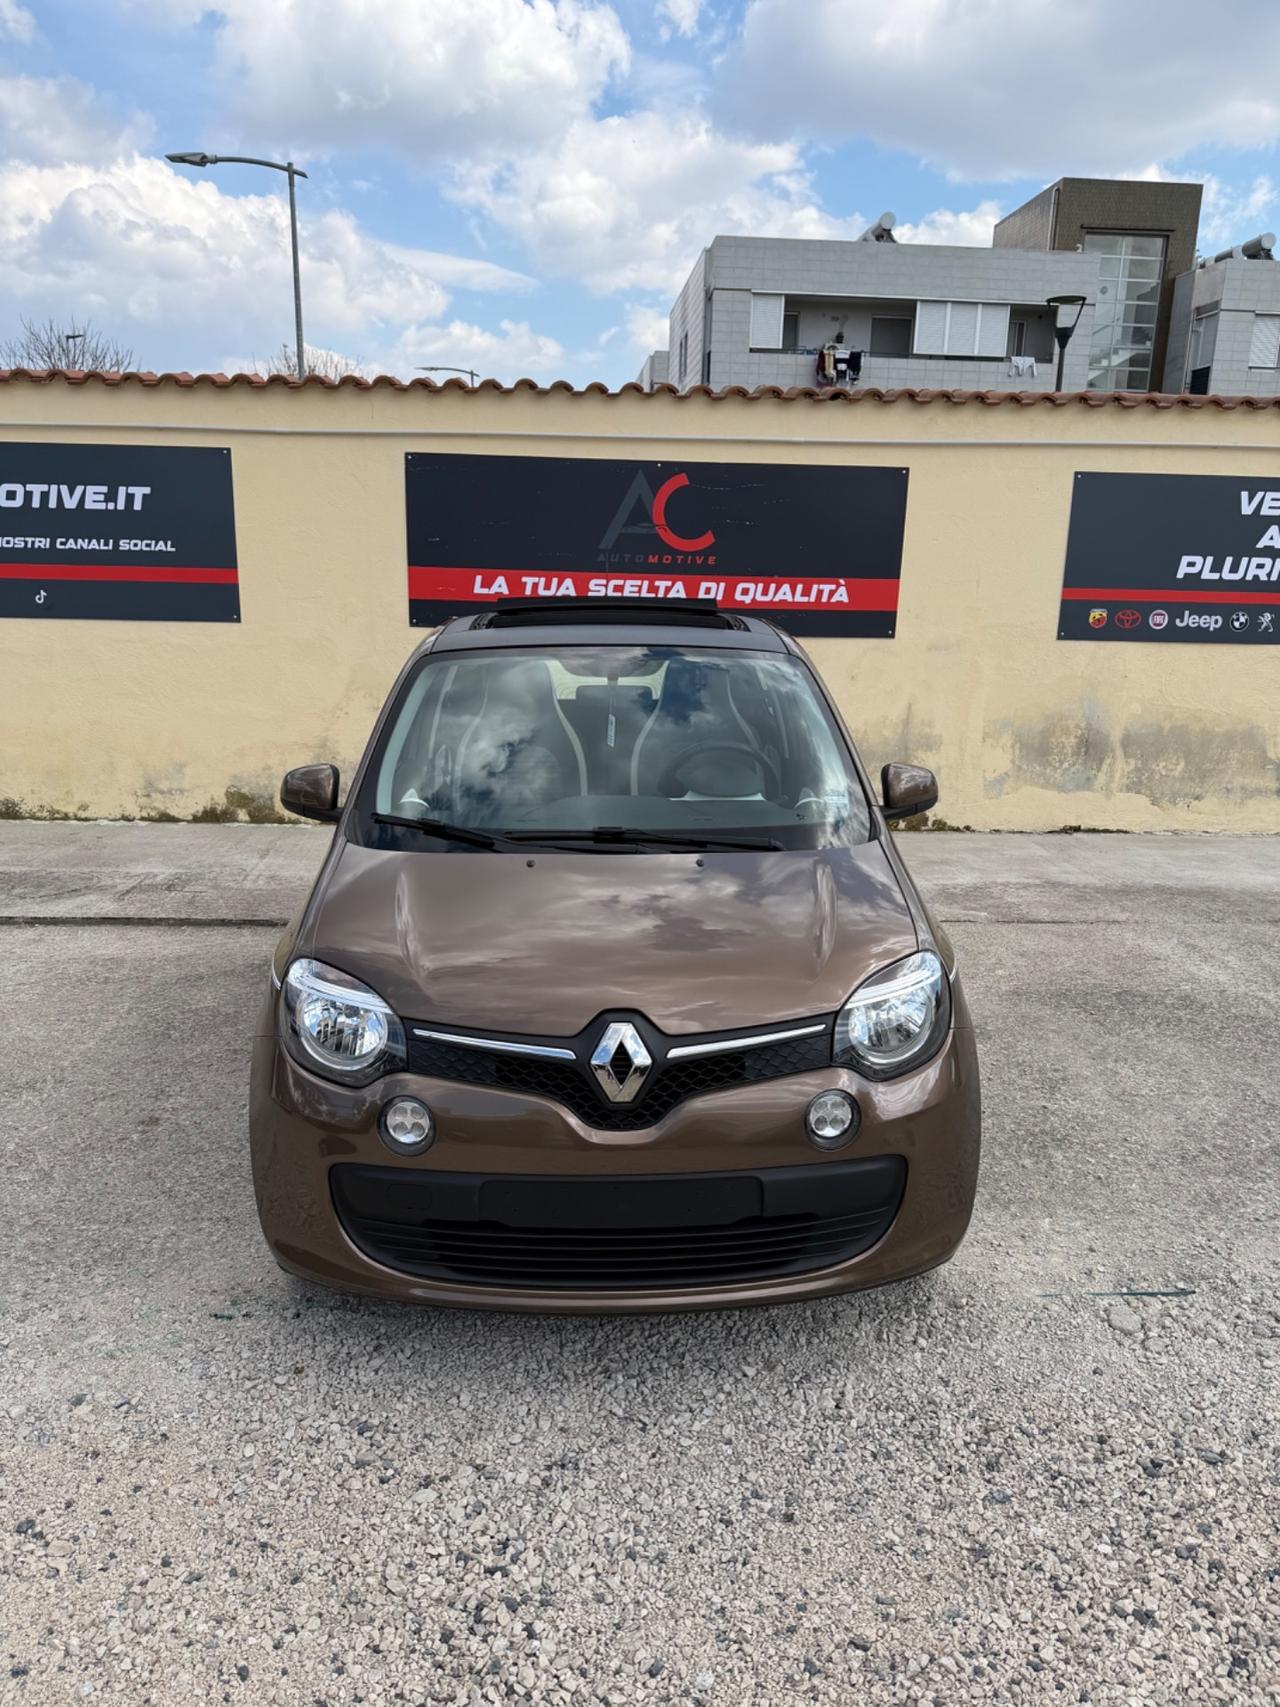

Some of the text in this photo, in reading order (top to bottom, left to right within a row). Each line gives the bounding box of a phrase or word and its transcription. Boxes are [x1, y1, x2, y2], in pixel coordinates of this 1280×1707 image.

[0, 537, 176, 552] OSTRI CANALI SOCIAL
[597, 554, 717, 565] AUTOMOTIVE
[473, 575, 849, 604] LA TUA SCELTA DI QUALITÀ
[1175, 610, 1223, 632] Jeep
